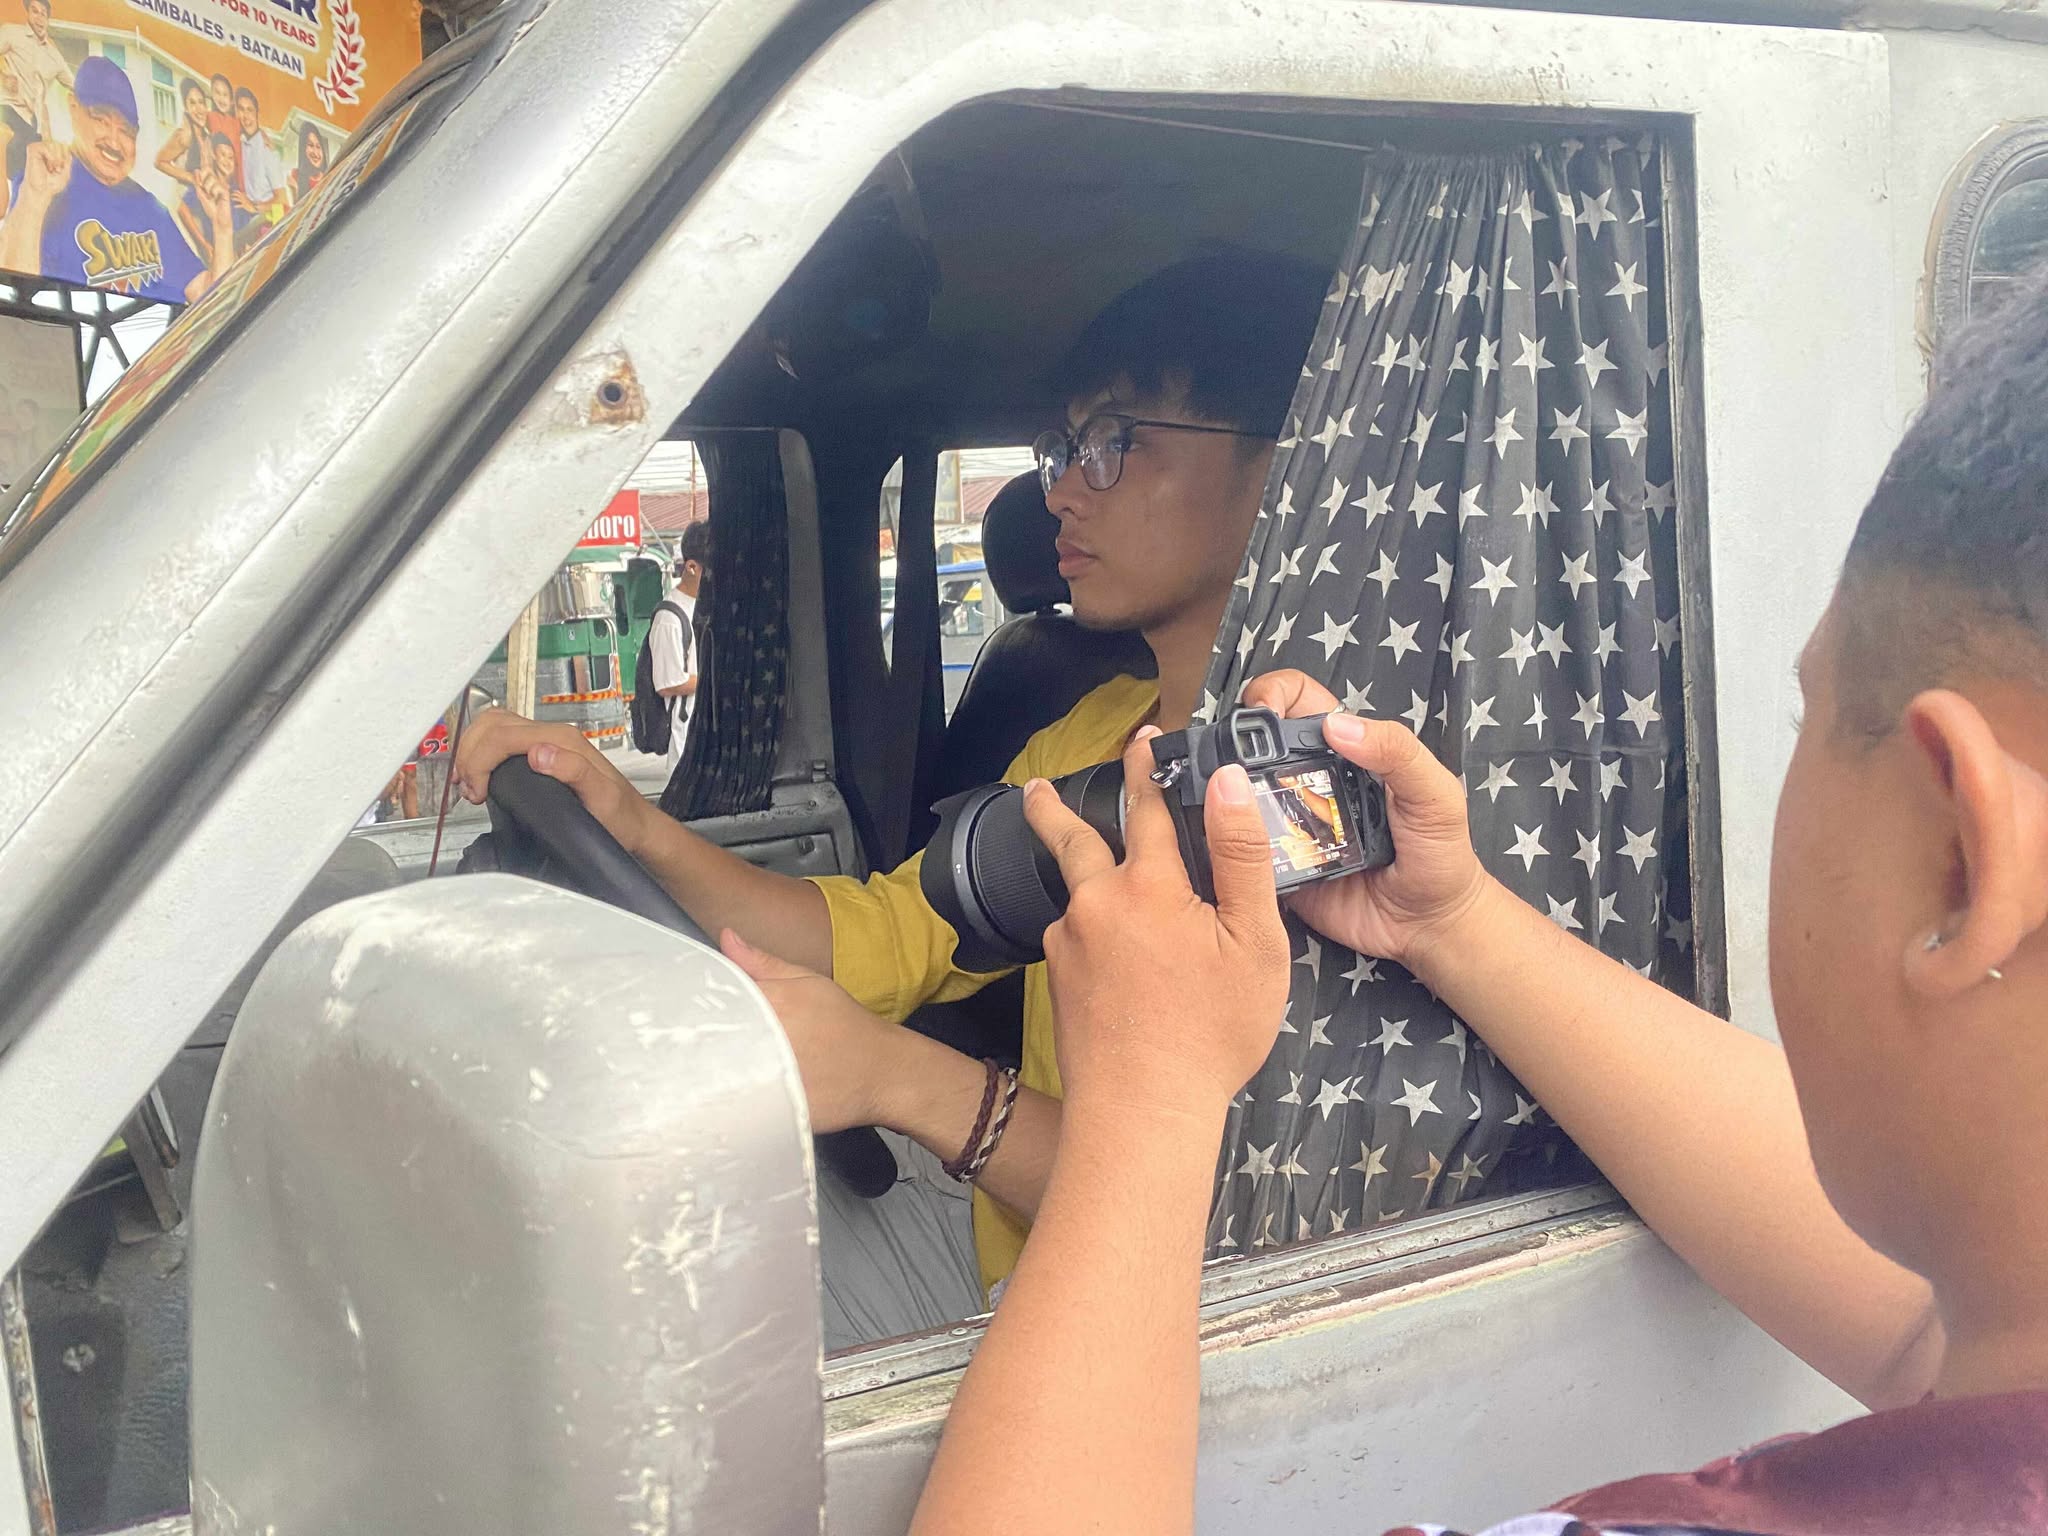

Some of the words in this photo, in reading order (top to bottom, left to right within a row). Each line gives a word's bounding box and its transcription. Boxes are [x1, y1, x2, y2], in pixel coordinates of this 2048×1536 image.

[253, 8, 268, 26] 10
[271, 15, 316, 48] YEARS
[241, 35, 302, 74] BATAAN
